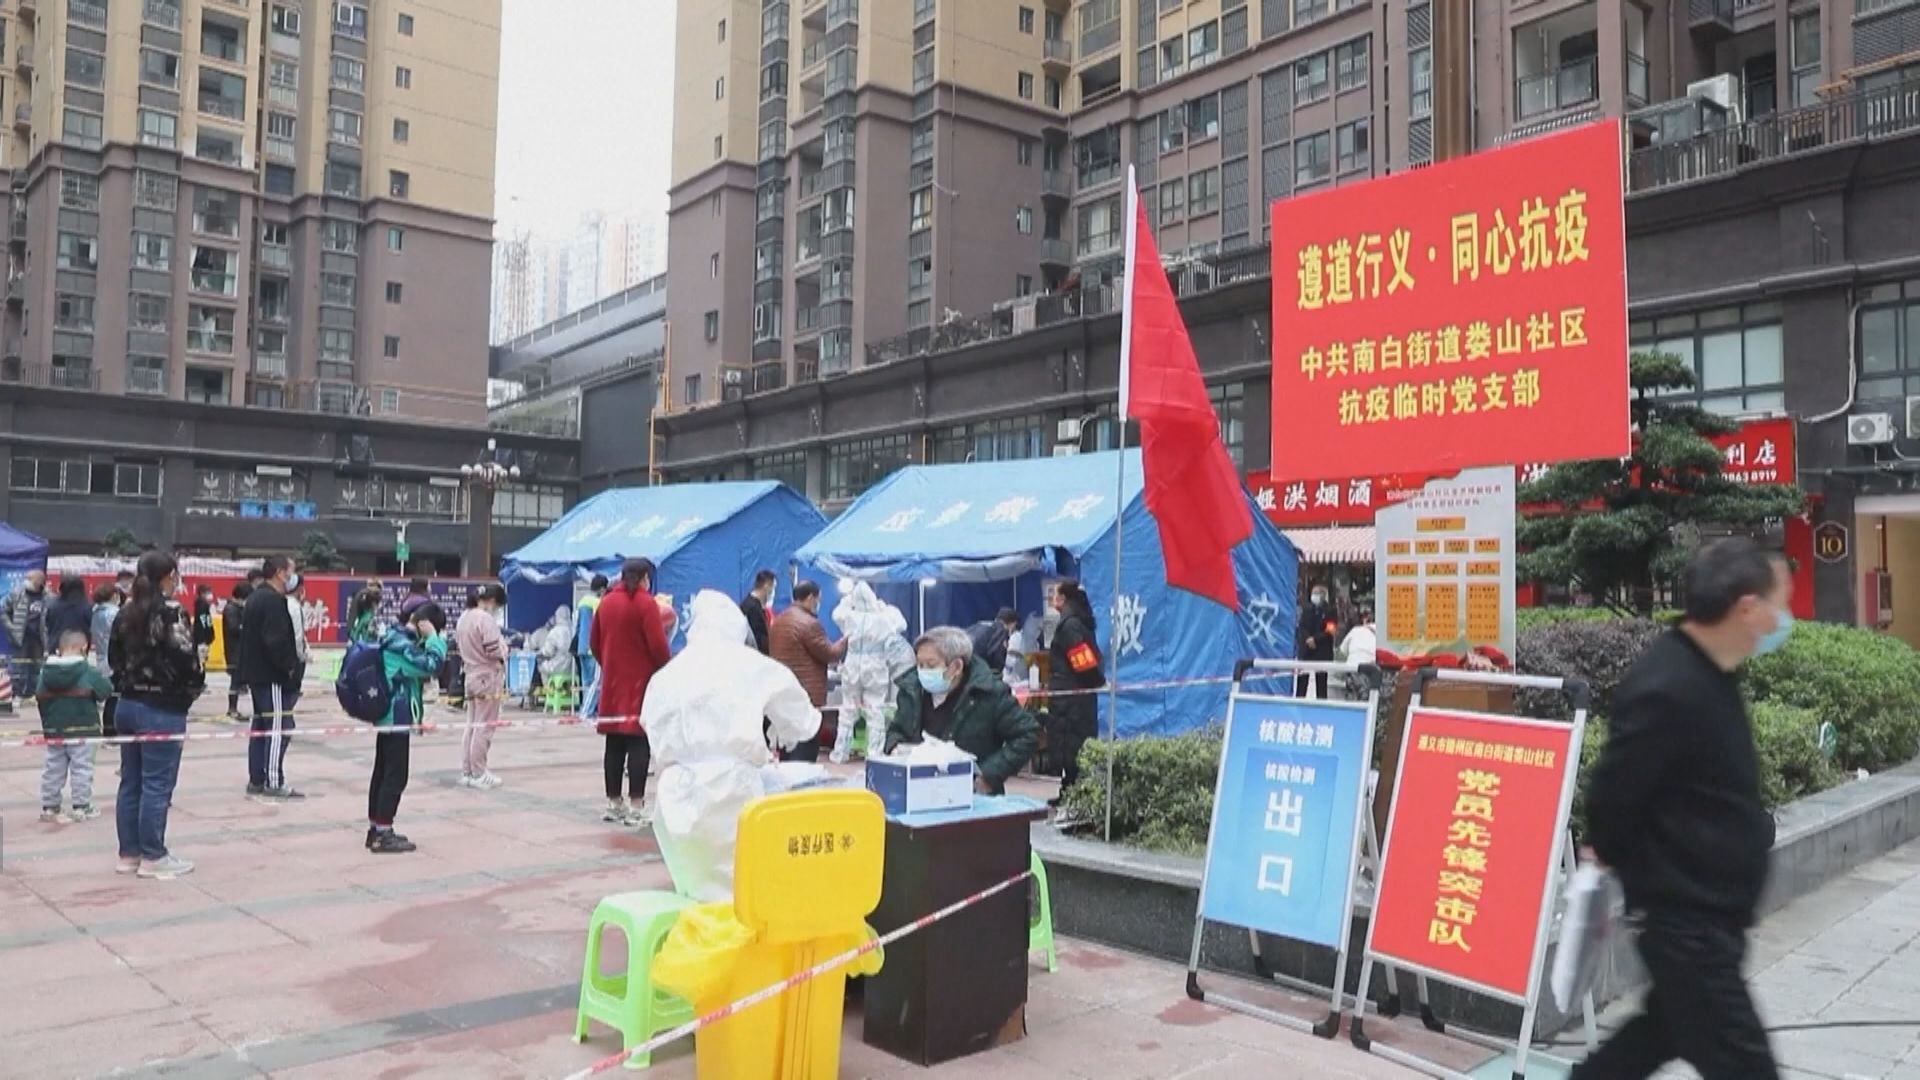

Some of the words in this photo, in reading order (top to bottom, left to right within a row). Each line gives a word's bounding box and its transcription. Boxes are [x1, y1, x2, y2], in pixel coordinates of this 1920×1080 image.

[1297, 188, 1589, 310] 遵道行义·同心抗疫
[1300, 307, 1588, 381] 中共南白街道娄山社区
[1338, 369, 1541, 426] 抗疫临时党支部
[1821, 535, 1843, 555] 10
[1258, 718, 1335, 749] 核酸检测
[1264, 759, 1316, 786] 核酸检测
[1256, 788, 1304, 898] 出口
[1428, 767, 1502, 953] 党员先锋突击队
